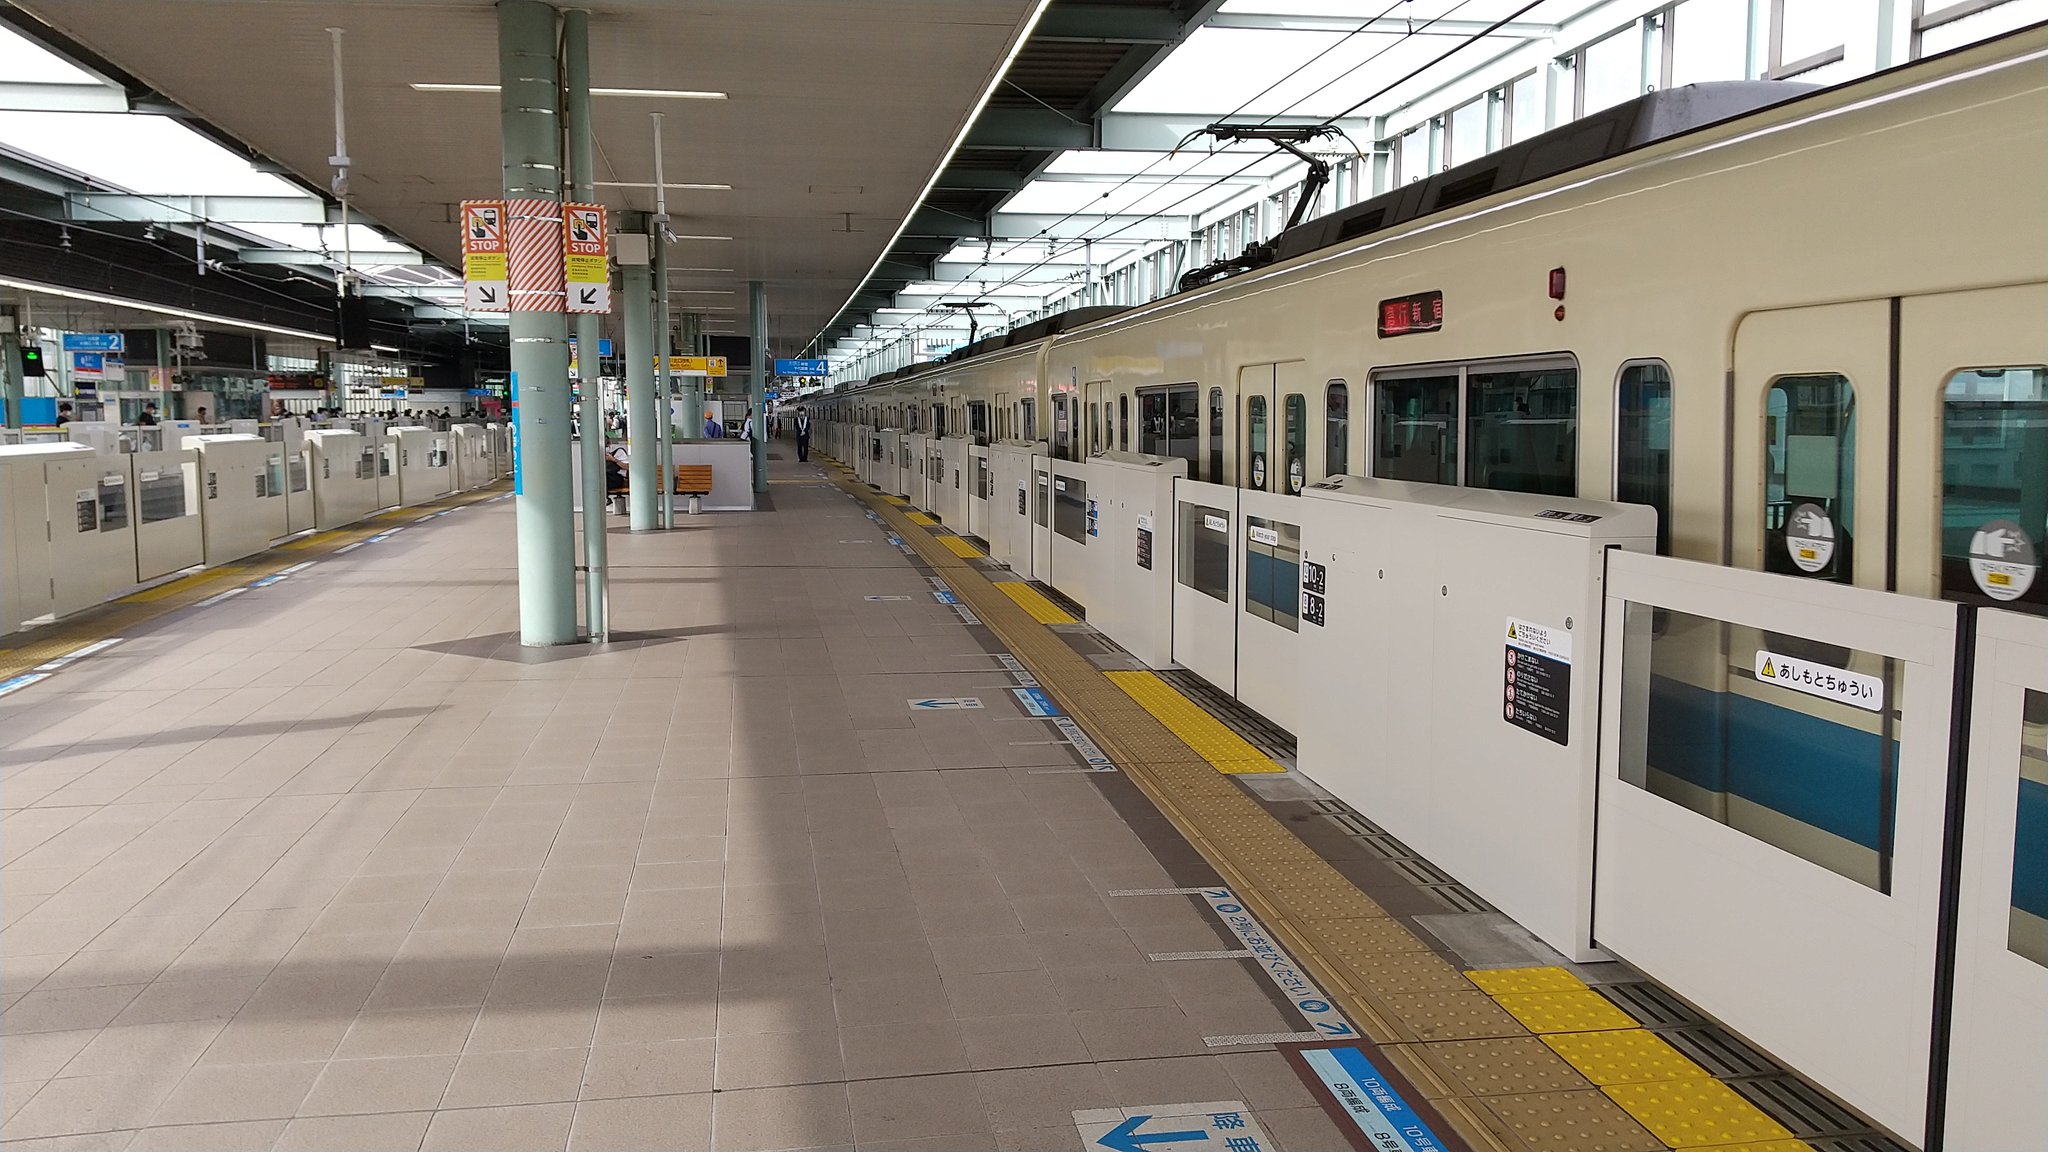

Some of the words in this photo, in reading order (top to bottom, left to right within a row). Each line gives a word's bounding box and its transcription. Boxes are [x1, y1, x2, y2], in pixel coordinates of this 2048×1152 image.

[470, 240, 500, 251] STOP
[571, 242, 601, 253] STOP
[108, 334, 120, 350] 2
[815, 360, 827, 375] 4
[1779, 662, 1873, 699] あしもとちゅうい
[1228, 915, 1311, 997] 2列にお並びください
